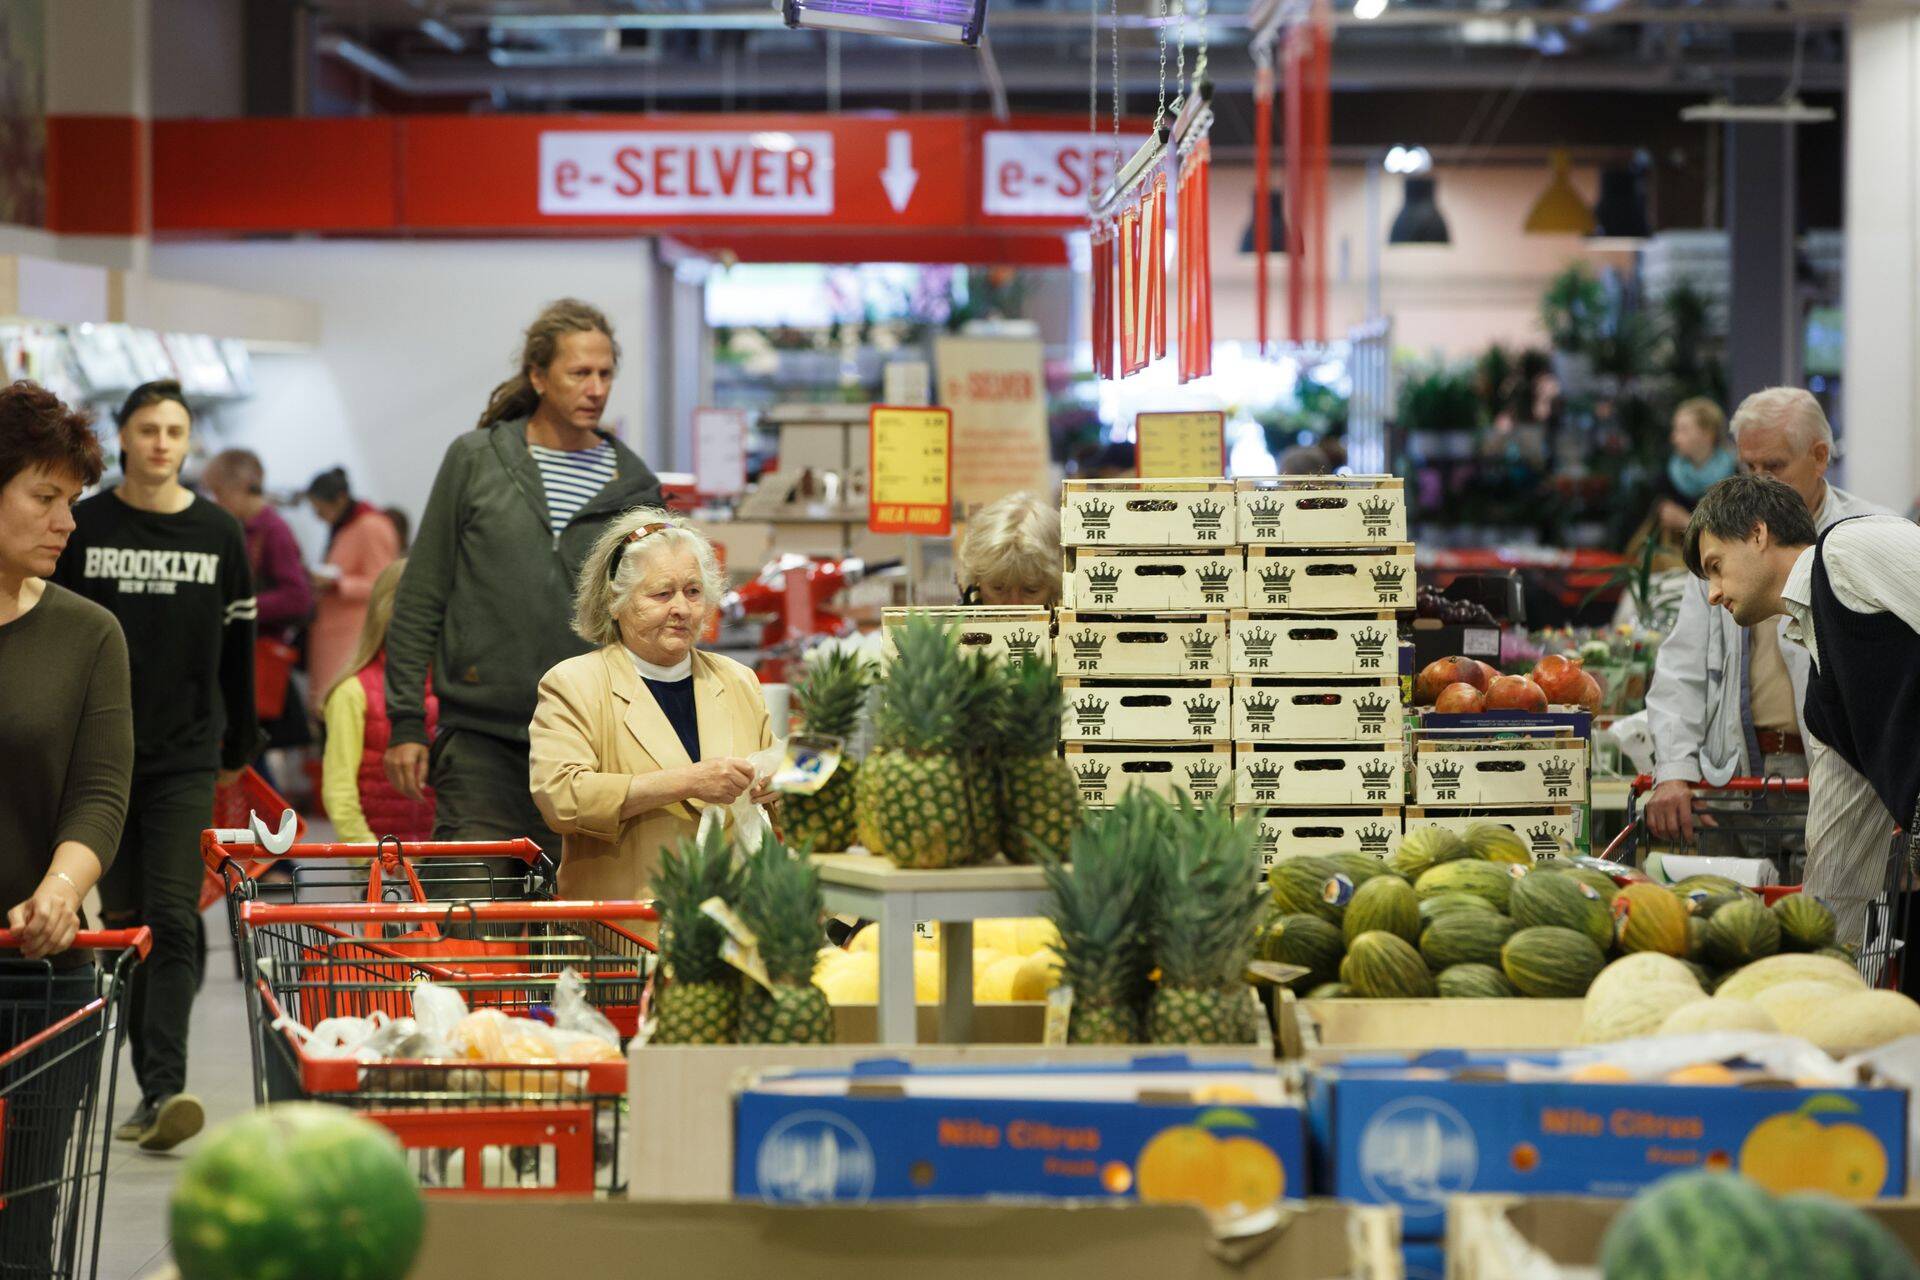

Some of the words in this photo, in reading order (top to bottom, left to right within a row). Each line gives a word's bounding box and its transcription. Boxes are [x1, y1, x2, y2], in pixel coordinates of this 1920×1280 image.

[554, 147, 815, 198] e-SELVER
[998, 147, 1136, 198] e-SE
[84, 547, 220, 585] BROOKLYN
